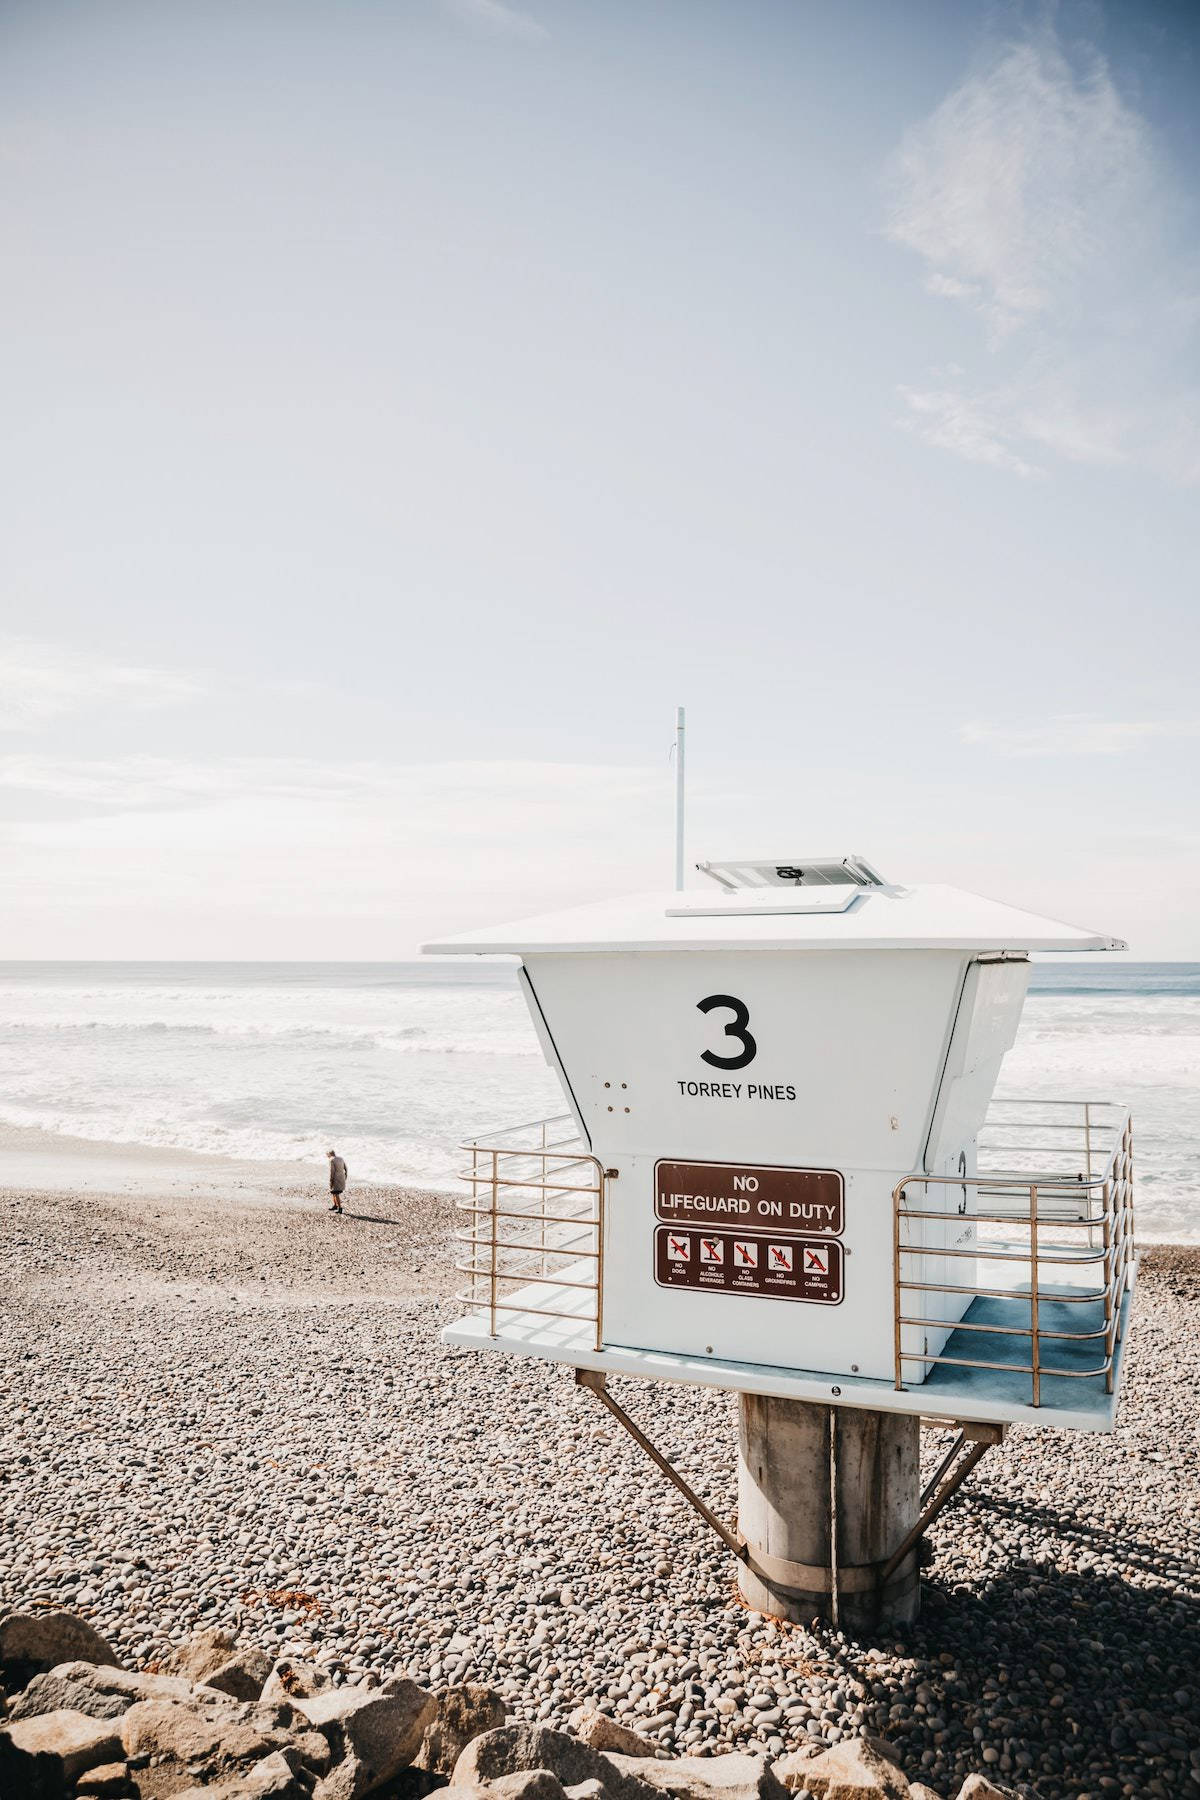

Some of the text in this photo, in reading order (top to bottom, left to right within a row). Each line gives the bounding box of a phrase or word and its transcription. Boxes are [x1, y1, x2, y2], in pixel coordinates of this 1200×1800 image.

[696, 994, 757, 1070] 3
[677, 1081, 796, 1101] TORREY PINES
[733, 1175, 759, 1192] NO
[661, 1193, 836, 1220] LIFEGUARD ON DUTY
[699, 1271, 724, 1279] ALCOHOLIC
[699, 1277, 725, 1285] BEVERAGES
[732, 1280, 760, 1288] CONTAINERS
